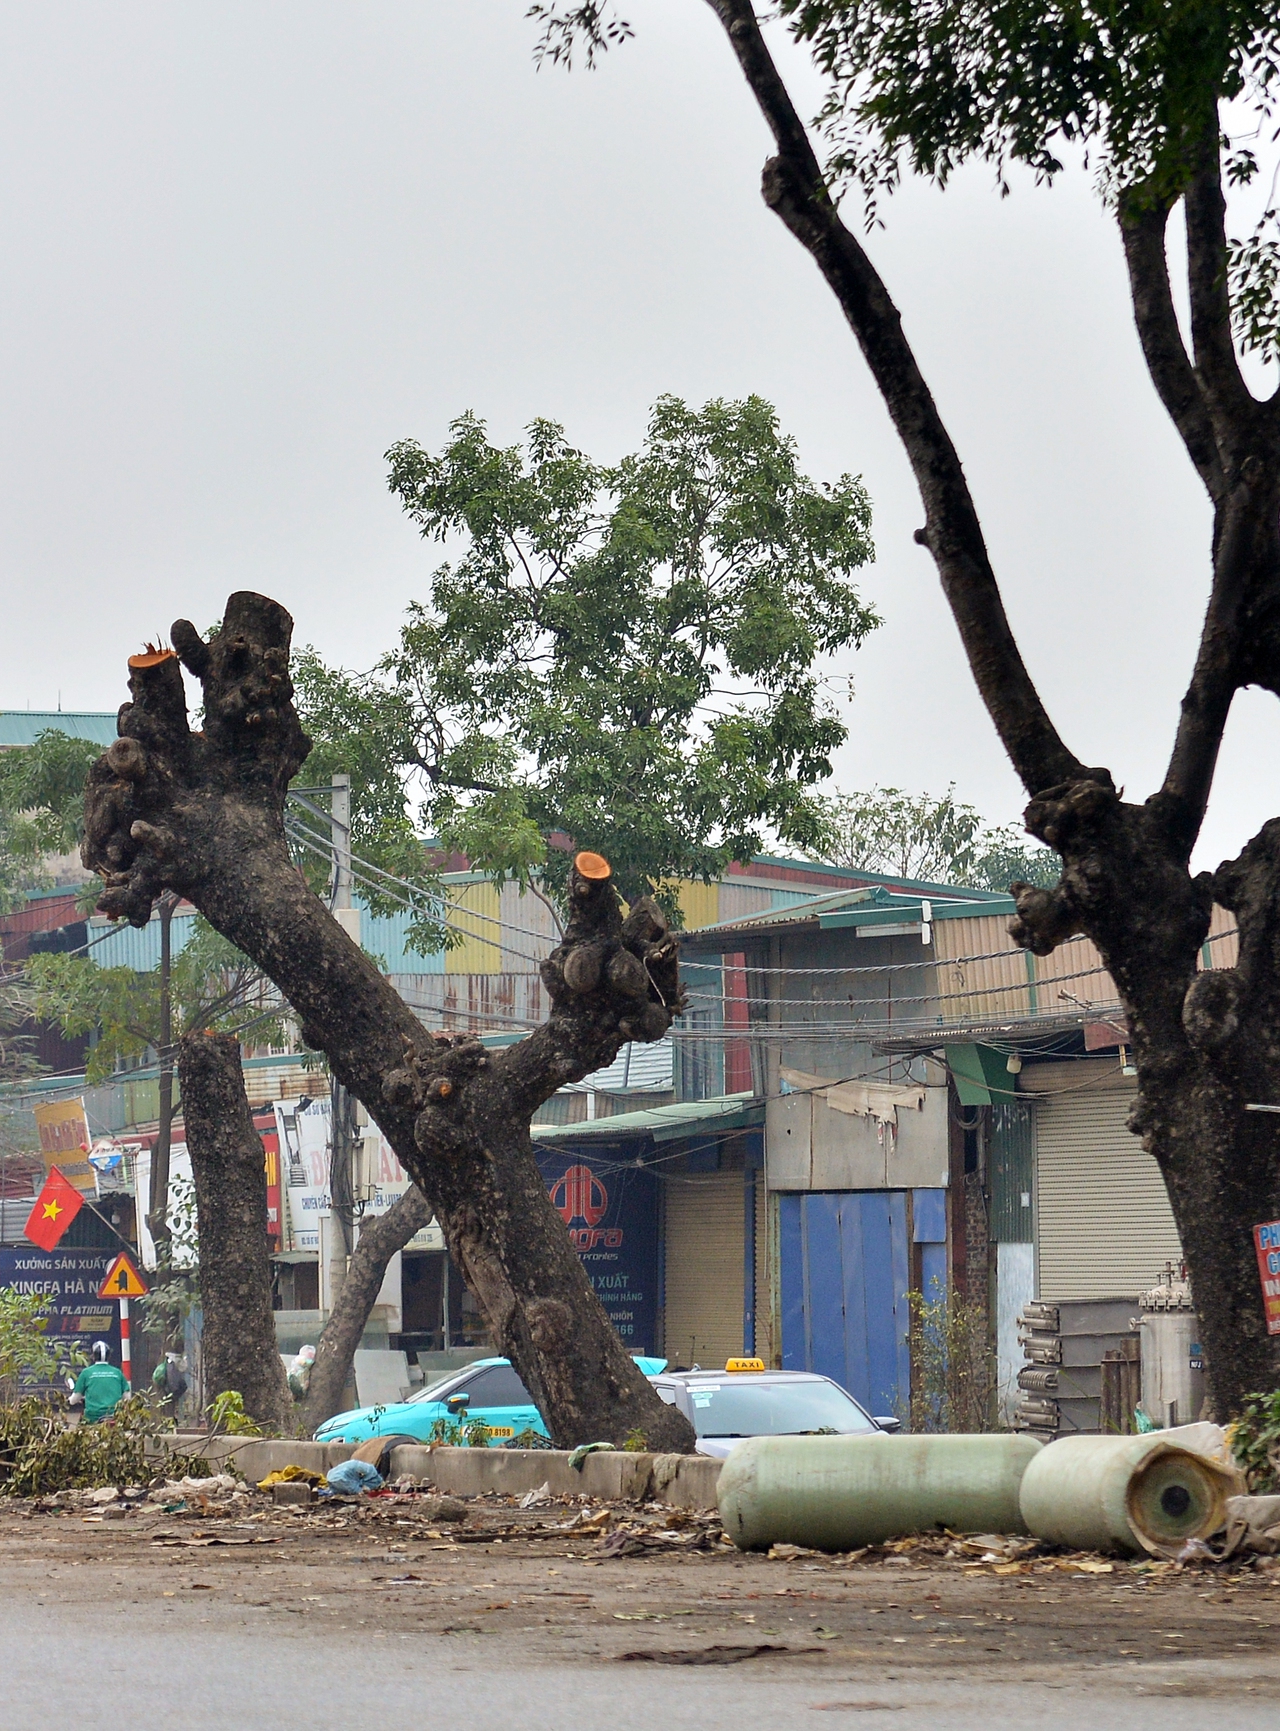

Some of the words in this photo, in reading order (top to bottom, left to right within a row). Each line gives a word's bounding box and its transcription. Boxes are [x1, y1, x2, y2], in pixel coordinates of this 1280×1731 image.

[9, 1281, 60, 1294] XINGFA
[65, 1278, 85, 1294] HÀ
[598, 1272, 629, 1289] XUẤT
